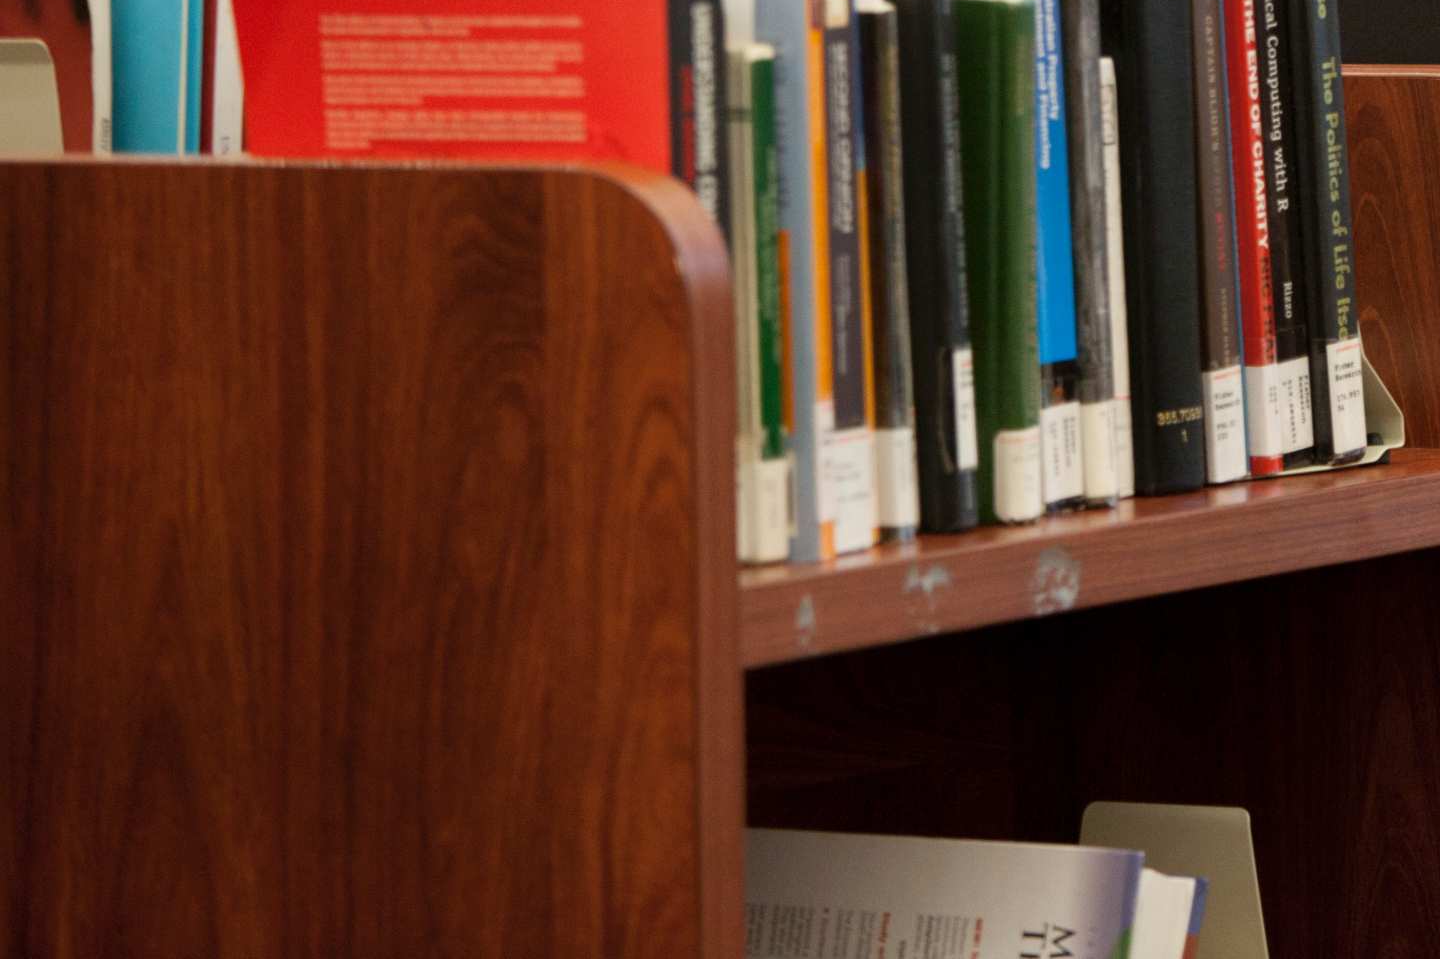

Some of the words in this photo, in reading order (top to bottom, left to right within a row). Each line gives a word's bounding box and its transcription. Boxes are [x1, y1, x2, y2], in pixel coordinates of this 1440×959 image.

[1048, 53, 1059, 120] Property
[1246, 49, 1259, 101] END
[1265, 35, 1284, 143] Computing
[1321, 56, 1338, 105] The
[1250, 102, 1262, 136] OF
[1275, 146, 1288, 192] with
[1325, 112, 1342, 203] Politics
[1251, 138, 1269, 249] CHARITY
[1277, 197, 1289, 212] R
[1330, 209, 1349, 237] of
[1332, 244, 1351, 290] Life
[1283, 280, 1294, 319] Rizzo
[1336, 297, 1351, 341] Itse
